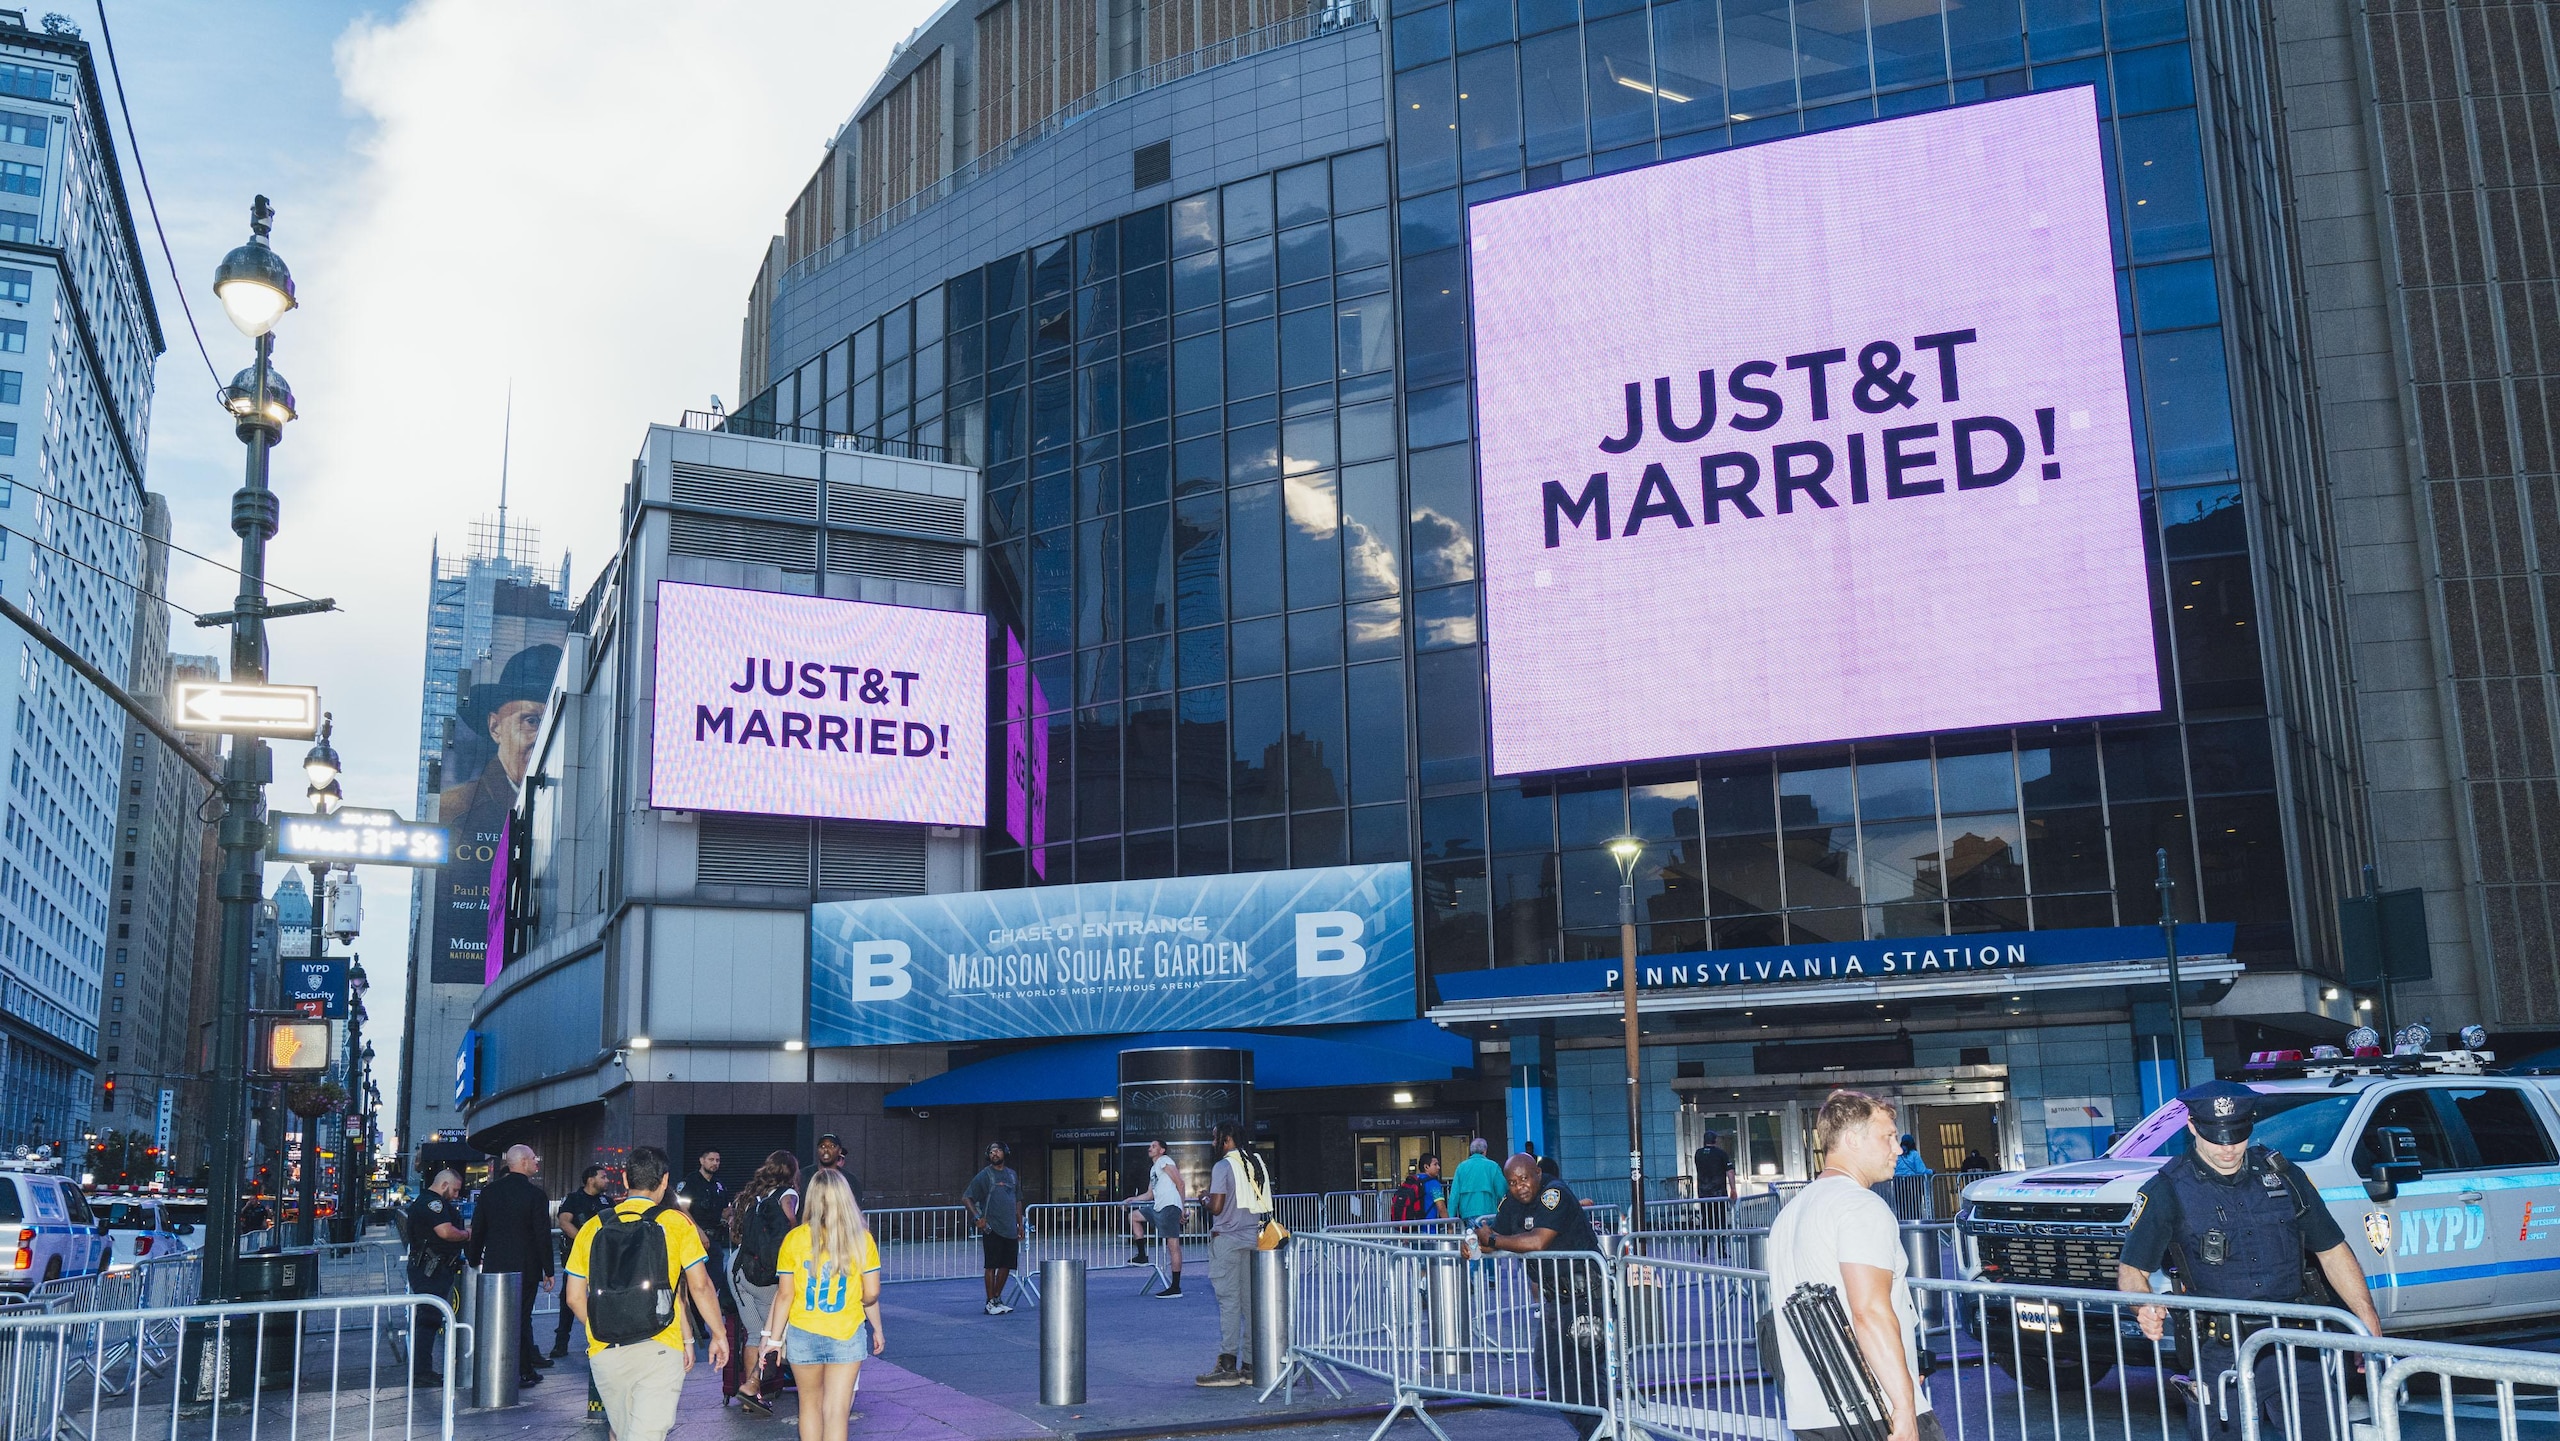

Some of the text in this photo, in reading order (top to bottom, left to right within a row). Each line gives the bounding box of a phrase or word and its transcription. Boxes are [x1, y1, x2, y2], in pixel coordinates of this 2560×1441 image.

[1597, 327, 1978, 455] JUST&T
[1541, 406, 2063, 550] MARRIED!
[730, 657, 920, 707] JUST&T
[695, 704, 950, 760] MARRIED!
[409, 832, 439, 858] St
[476, 832, 502, 841] EVE
[452, 902, 477, 910] new
[453, 884, 478, 896] Paul
[989, 916, 1208, 944] CHASE ENTRANCE
[1295, 910, 1367, 978] B
[301, 964, 330, 973] NYPD
[450, 952, 484, 960] NATIONAL
[852, 939, 912, 1002] B
[948, 940, 1248, 990] MADISON SQUARE GARDEN
[1606, 944, 2025, 988] PNNSYLVANIA STATION
[294, 990, 335, 1001] Security
[990, 982, 1200, 999] THE WORLD'S MOST FAMOUS ARENA
[1163, 1112, 1202, 1130] SQUARE
[2400, 1204, 2485, 1256] NYPD
[802, 1259, 847, 1313] 10
